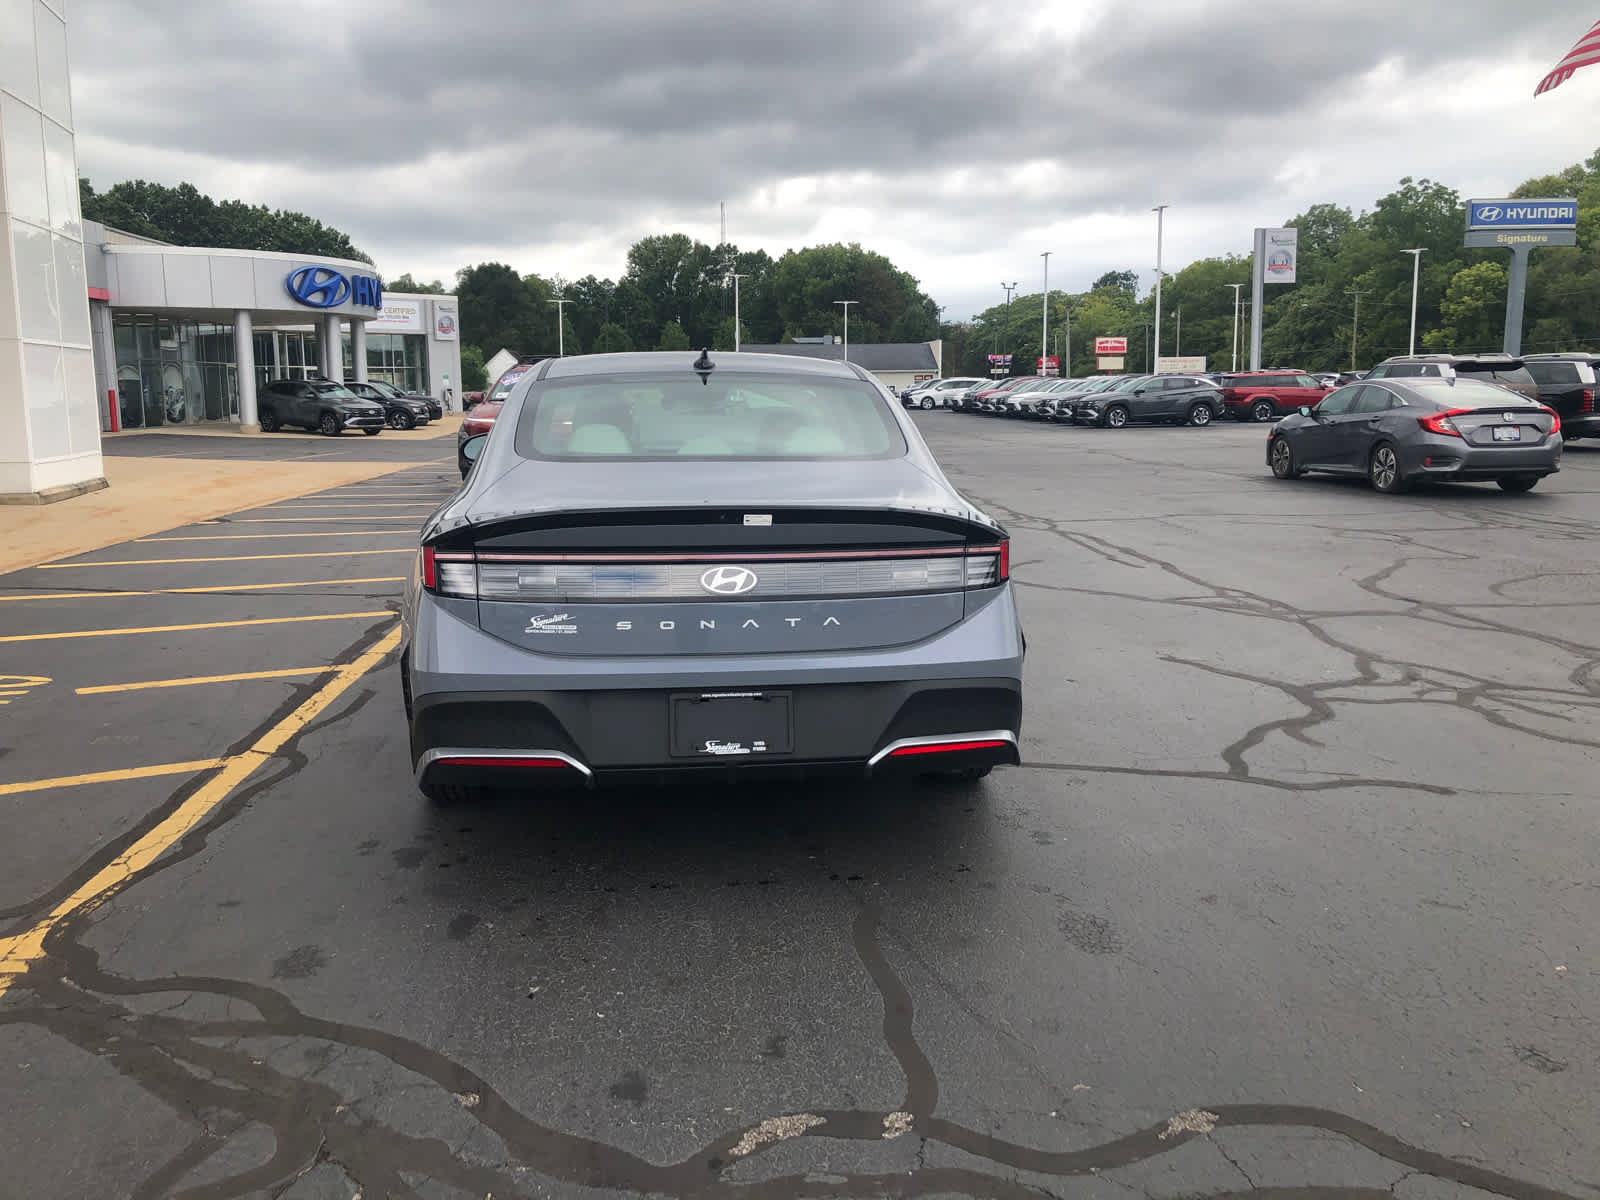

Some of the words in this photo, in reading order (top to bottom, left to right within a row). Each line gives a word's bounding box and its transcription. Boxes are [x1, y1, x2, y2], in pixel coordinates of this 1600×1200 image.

[1506, 207, 1573, 219] HYUNDAI
[1497, 234, 1548, 244] Signature
[616, 616, 840, 630] SONATA
